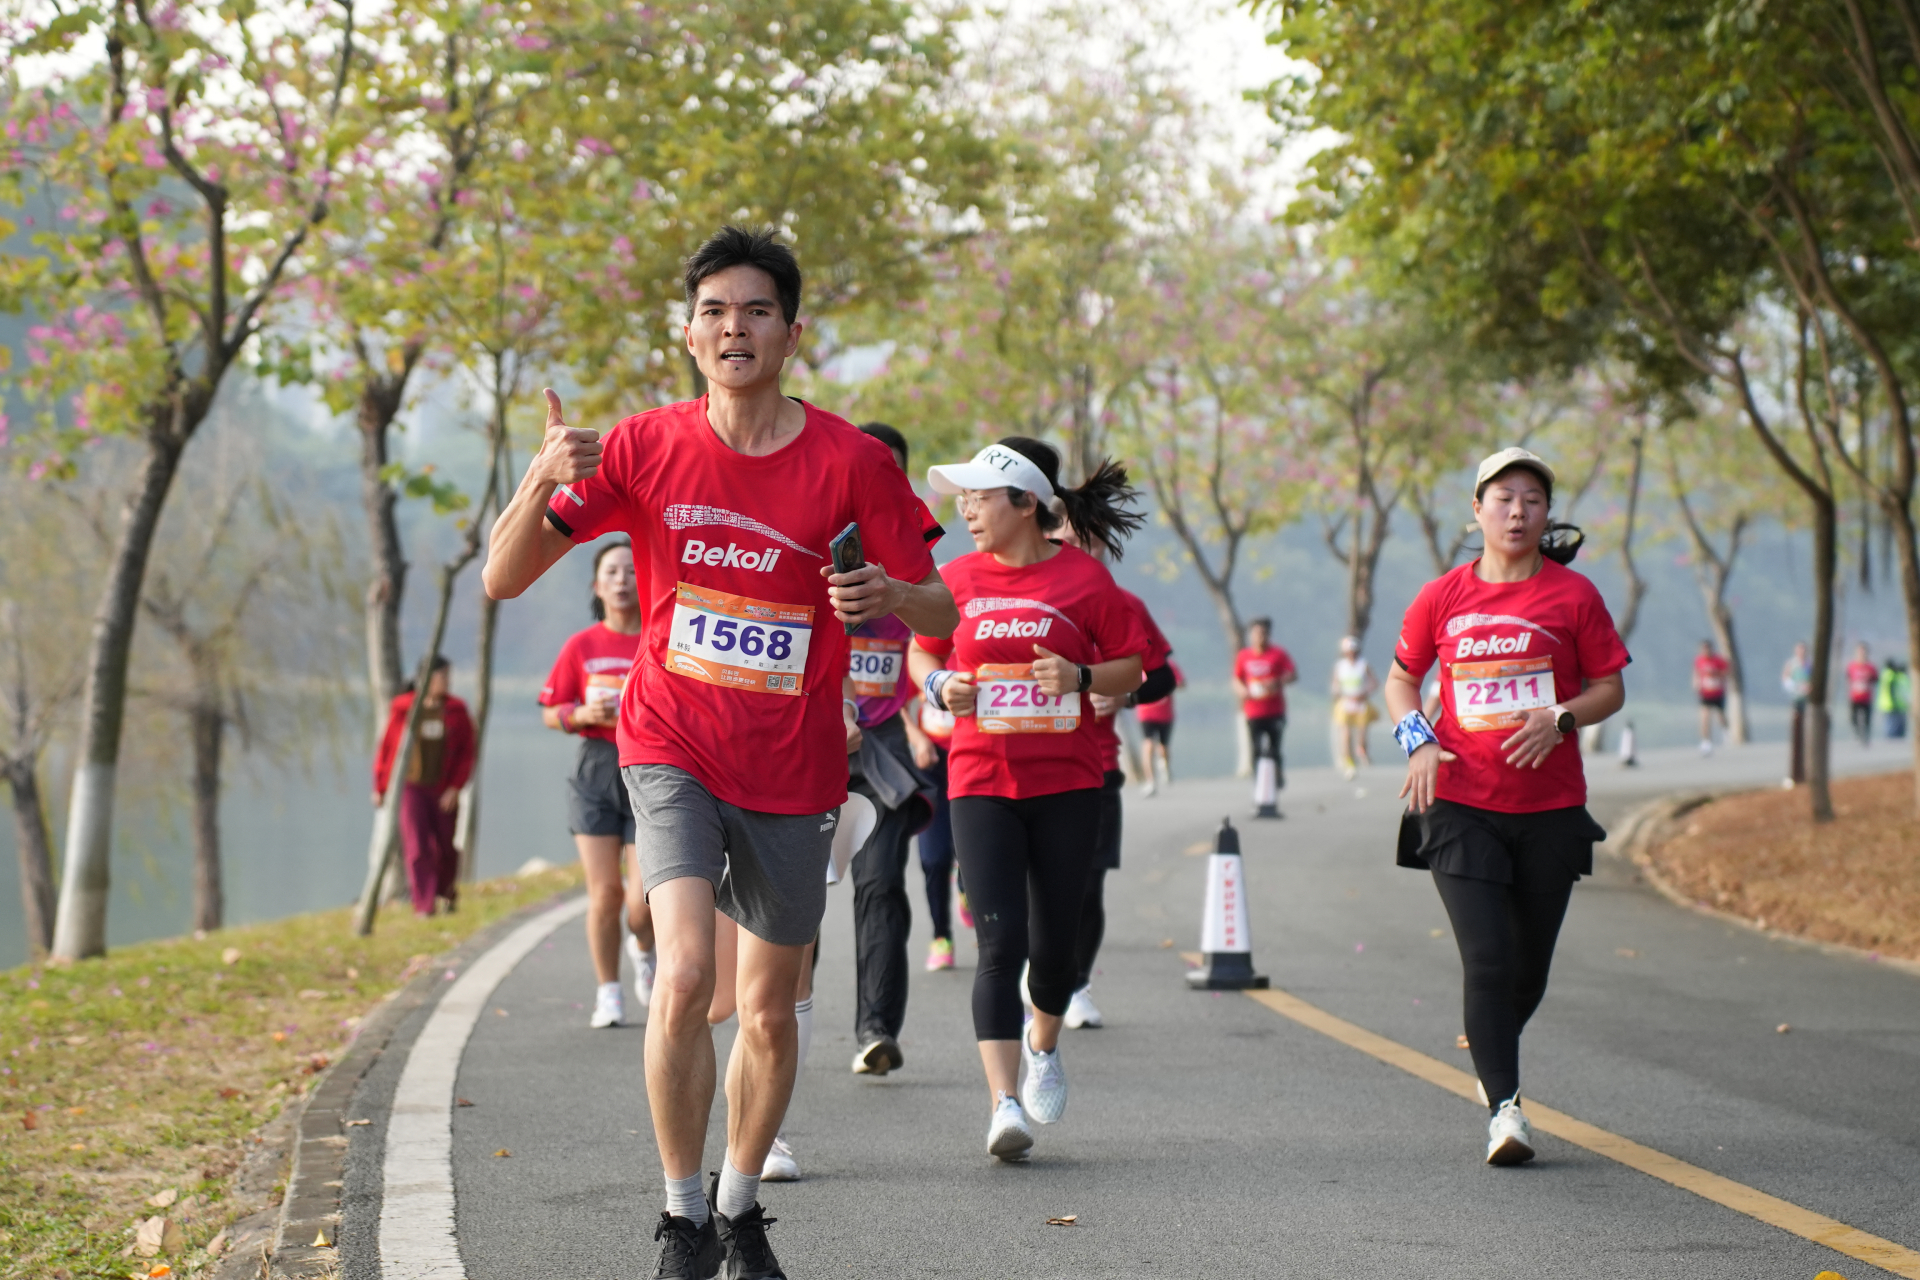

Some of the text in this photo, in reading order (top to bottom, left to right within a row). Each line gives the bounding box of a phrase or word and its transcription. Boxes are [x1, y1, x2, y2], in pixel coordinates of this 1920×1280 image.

[678, 508, 704, 524] 东莞
[689, 614, 792, 660] 1568
[1466, 677, 1539, 705] 2211
